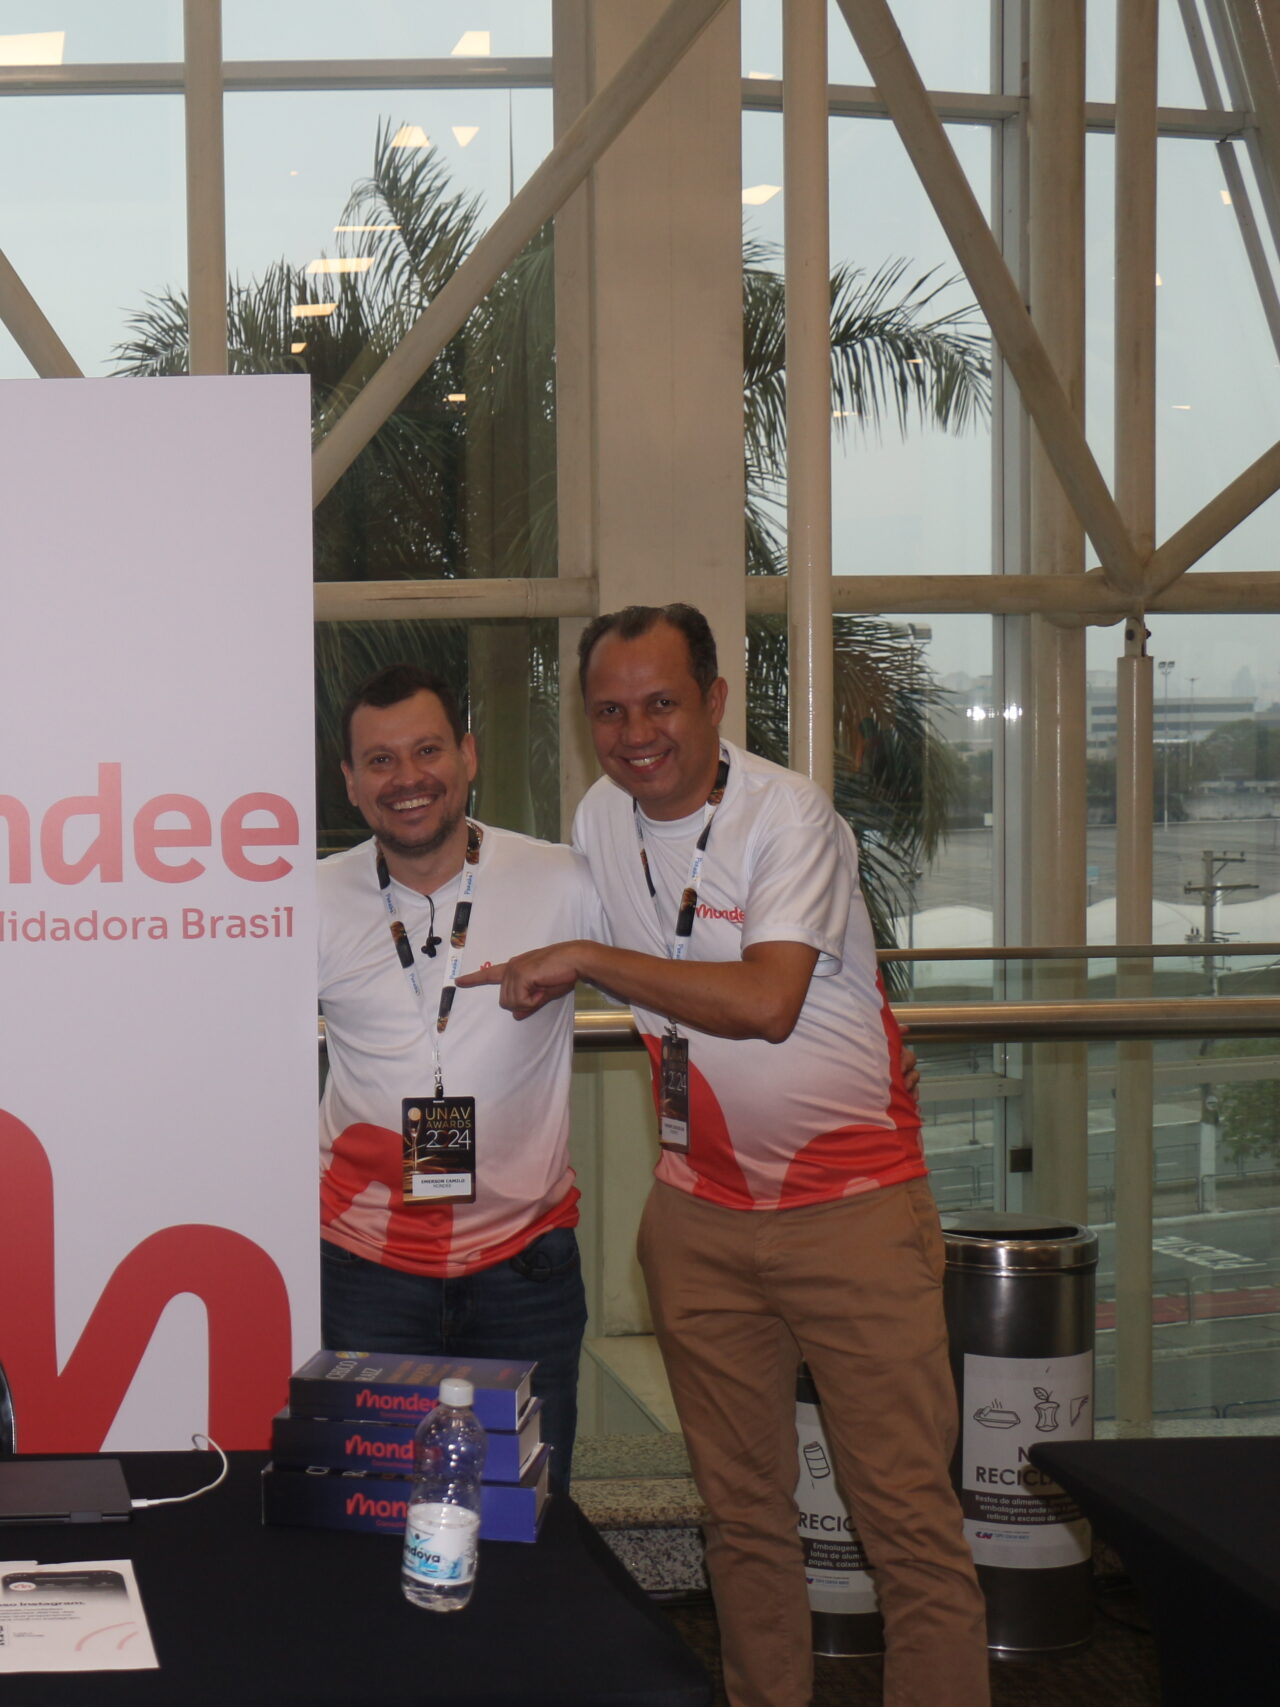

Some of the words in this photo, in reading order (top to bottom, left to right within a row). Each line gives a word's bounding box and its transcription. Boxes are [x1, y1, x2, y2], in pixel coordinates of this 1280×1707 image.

[181, 906, 295, 940] Brasil
[425, 1107, 471, 1120] UNAV
[425, 1120, 471, 1129] AWARDS
[426, 1129, 472, 1150] 2024
[345, 1434, 416, 1460] mond
[346, 1493, 409, 1518] mon
[980, 1504, 1027, 1514] embalagens
[1028, 1505, 1047, 1514] onde
[999, 1497, 1010, 1505] de
